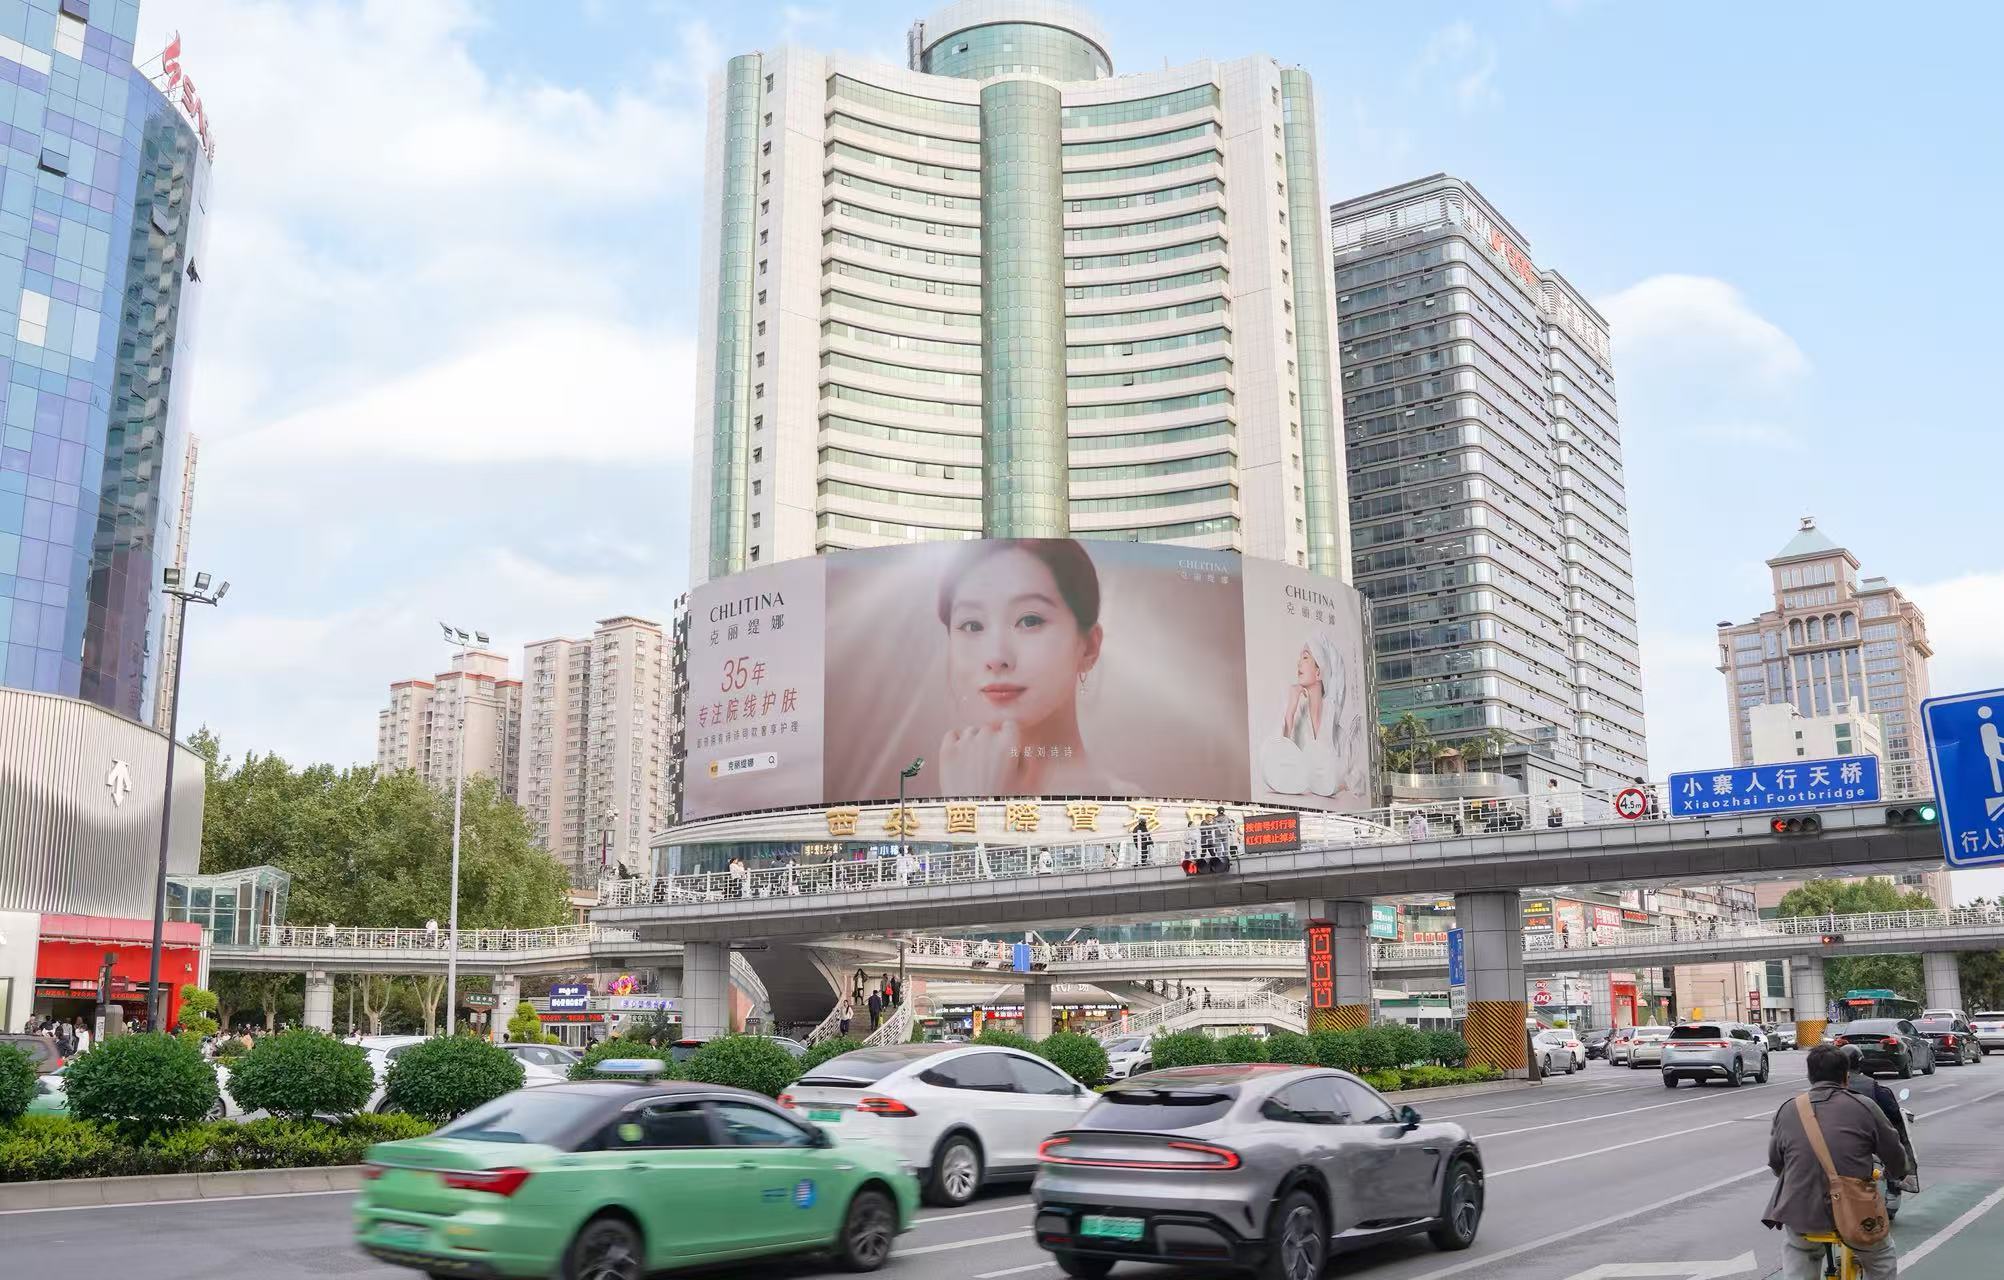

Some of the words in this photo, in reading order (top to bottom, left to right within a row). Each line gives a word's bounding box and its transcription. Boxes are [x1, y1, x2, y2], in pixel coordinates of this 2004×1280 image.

[1178, 559, 1230, 573] CHLITINA
[710, 592, 784, 622] CHLITINA
[1285, 584, 1336, 610] CHLITINA
[1286, 602, 1336, 626] 克丽缇娜
[709, 614, 784, 646] 克丽缇娜
[721, 656, 765, 692] 35年
[697, 688, 797, 728] 专注院线护肤
[1010, 746, 1072, 758] 我是刘诗诗
[728, 758, 754, 771] 克丽缇娜
[1682, 763, 1864, 797] 小寨人行天桥
[1684, 795, 1757, 810] Xiaozhai
[1767, 786, 1866, 805] Footbridge
[1245, 819, 1297, 833] 按信号灯行驶
[1246, 832, 1297, 845] 红灯禁止掉头
[1536, 994, 1550, 1002] DQ
